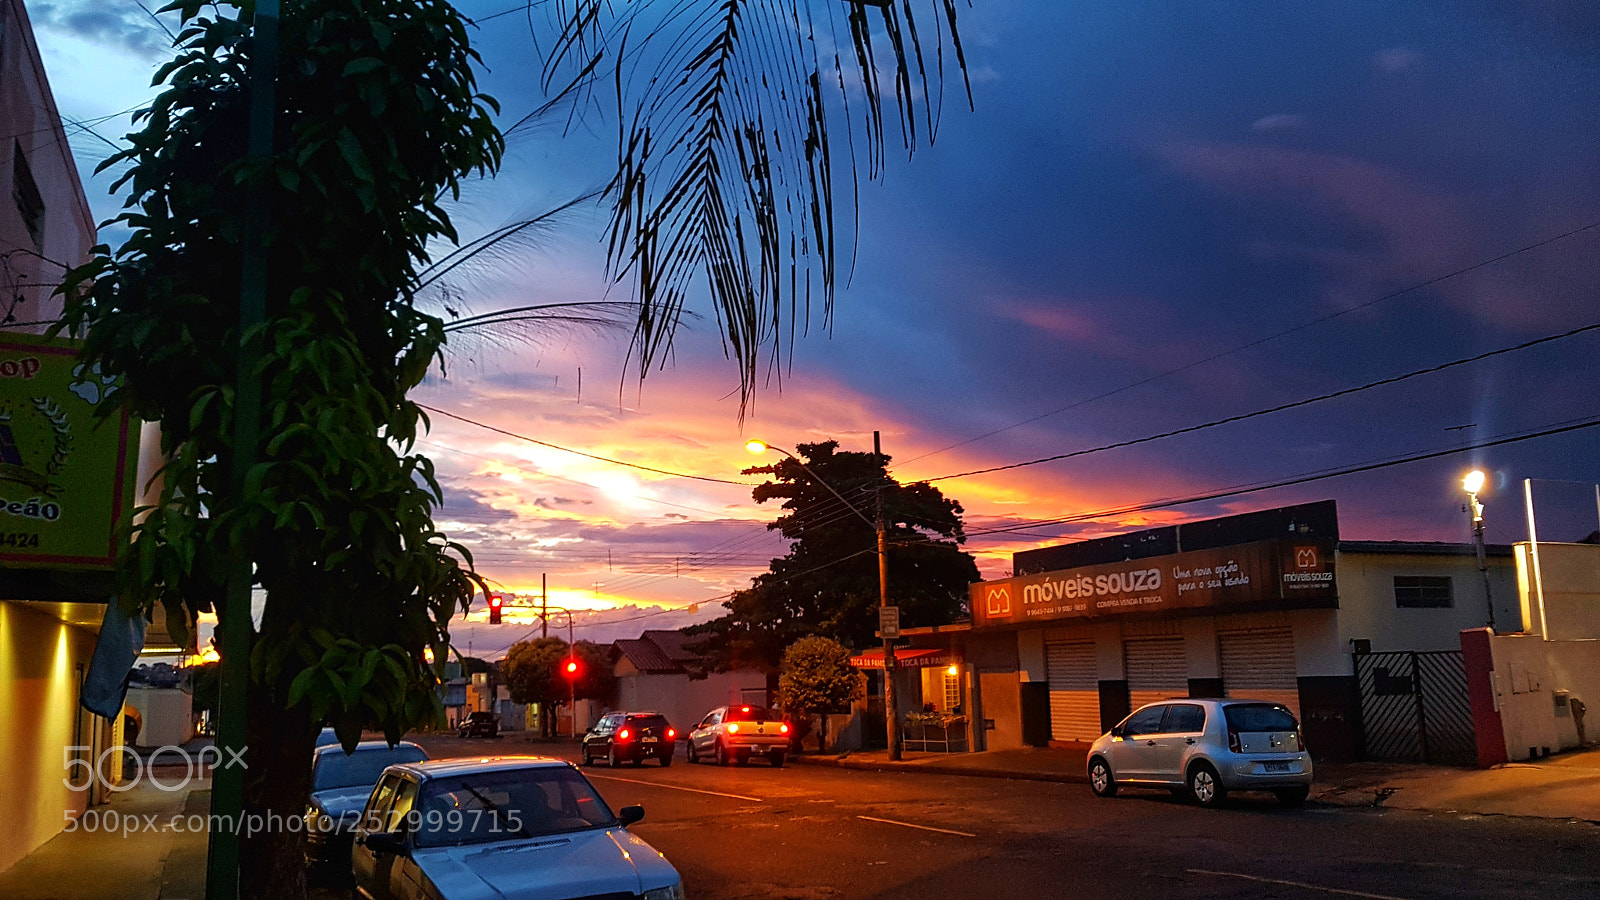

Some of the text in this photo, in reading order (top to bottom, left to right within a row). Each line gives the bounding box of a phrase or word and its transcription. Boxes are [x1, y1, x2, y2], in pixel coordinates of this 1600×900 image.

[1173, 560, 1238, 579] Uma nova opção
[1177, 572, 1250, 596] para o seu usado
[1096, 595, 1163, 608] COMPRA VENDA E TROCA
[850, 658, 863, 666] TOCA
[900, 658, 919, 667] TOCA
[919, 657, 930, 666] DA
